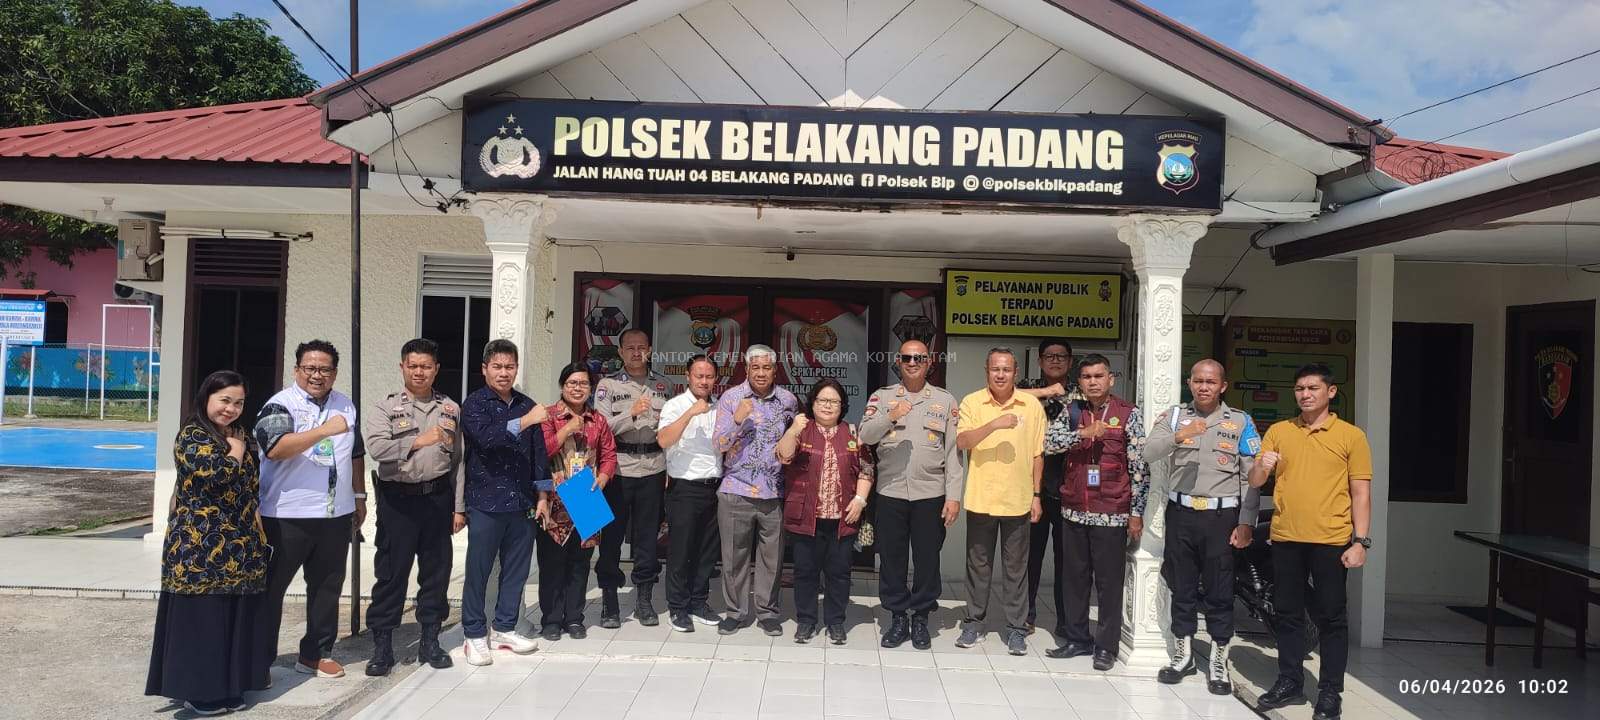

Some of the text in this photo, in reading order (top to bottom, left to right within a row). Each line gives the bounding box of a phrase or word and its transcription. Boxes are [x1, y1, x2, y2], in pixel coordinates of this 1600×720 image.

[553, 116, 1124, 171] POLSEK BELAKANG PADANG
[553, 166, 1123, 195] JALAN HANG TUAH 04 BELAKANG PADANG Polsek Blp @polsekblkpadang
[975, 280, 1089, 295] PELAYANAN PUBLIK
[1000, 297, 1054, 310] TERPADU
[952, 313, 1114, 329] POLSEK BELAKANG PADANG
[792, 367, 847, 378] SPKT POLSEK
[926, 411, 946, 420] POLRI
[1216, 431, 1239, 440] POLRI
